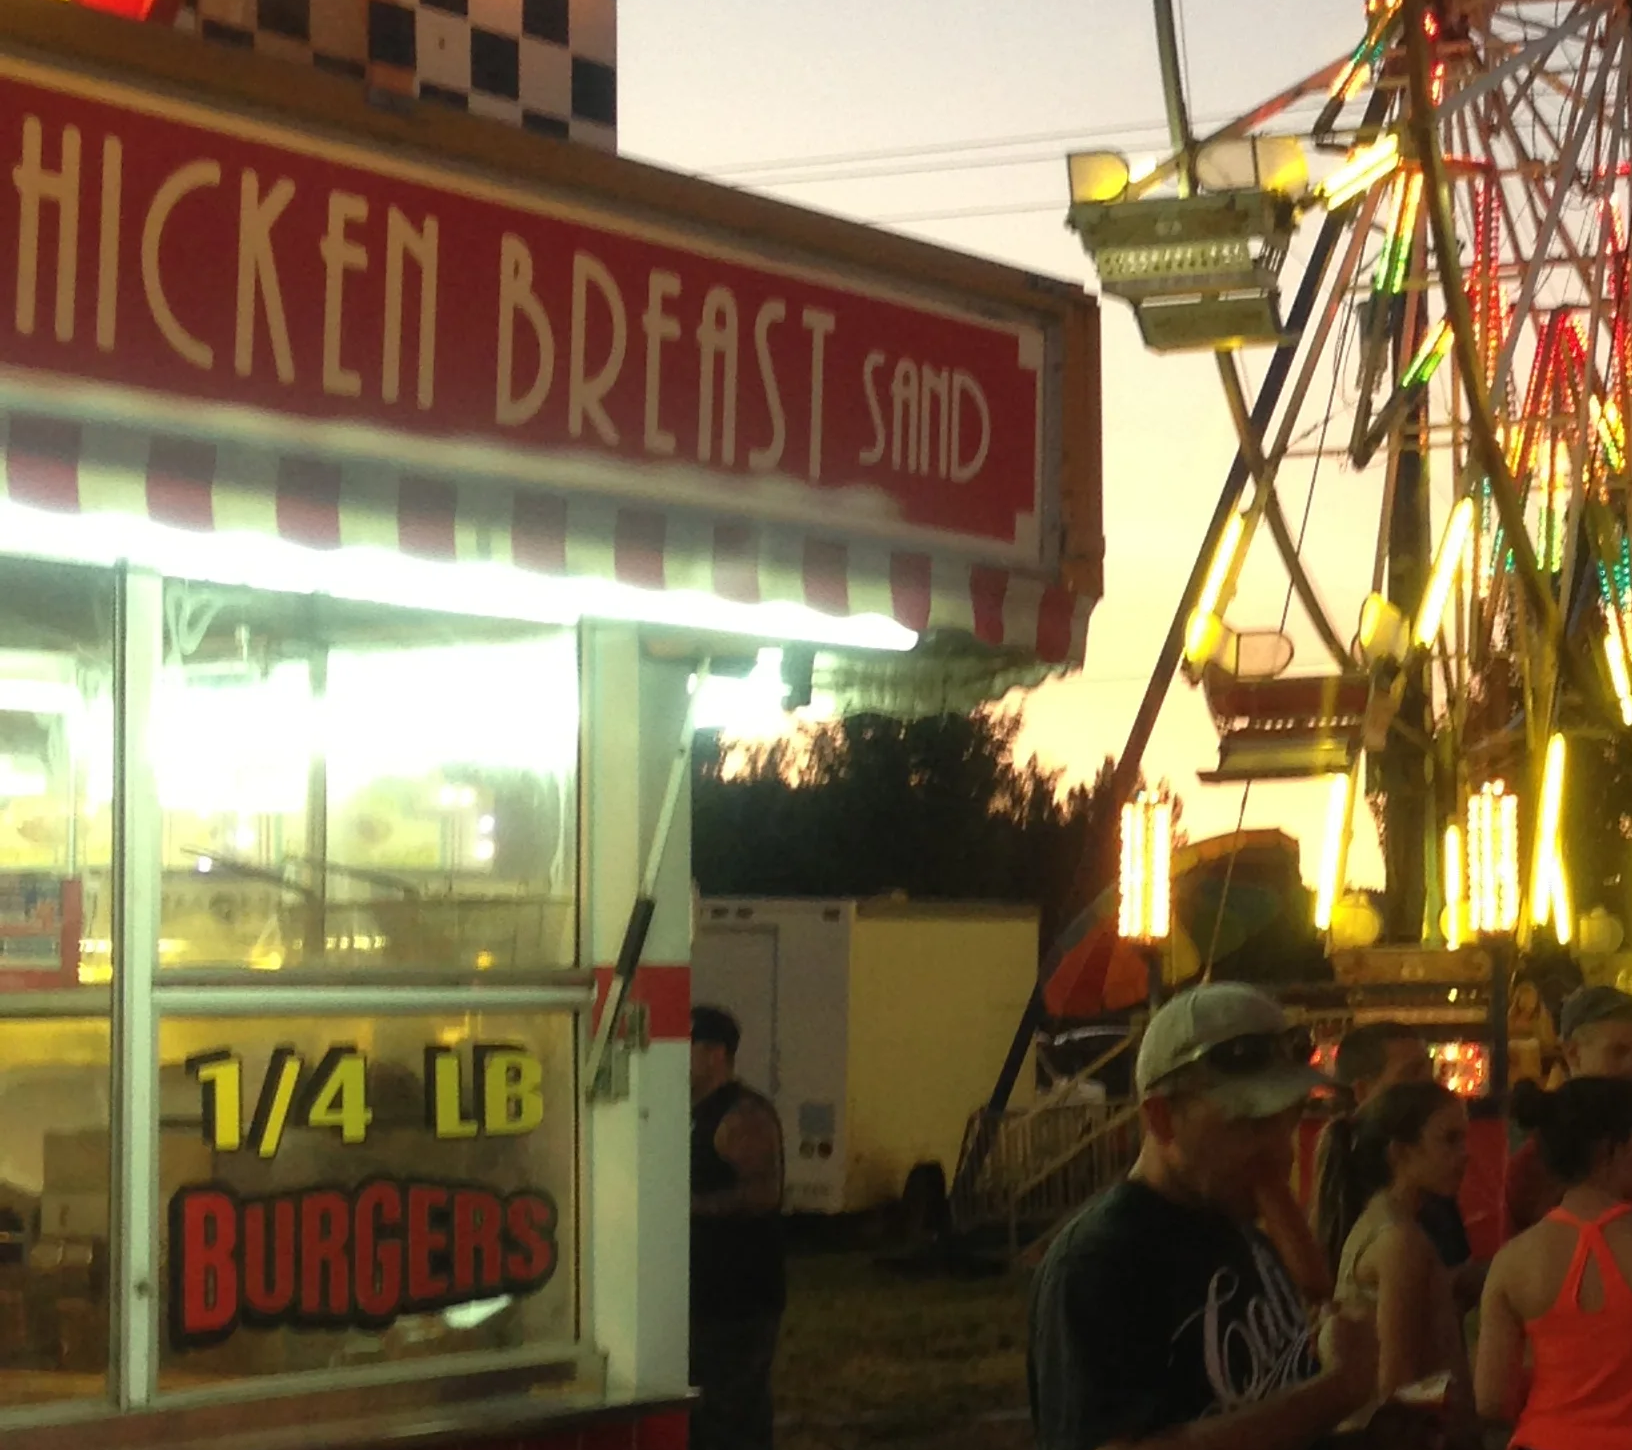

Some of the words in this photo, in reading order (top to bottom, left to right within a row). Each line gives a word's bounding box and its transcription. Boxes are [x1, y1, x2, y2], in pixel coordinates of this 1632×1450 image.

[496, 231, 836, 481] BREAST
[858, 347, 991, 483] SAND
[188, 1044, 373, 1159] 1/4
[424, 1043, 545, 1141] LB
[180, 1178, 554, 1335] BURGERS
